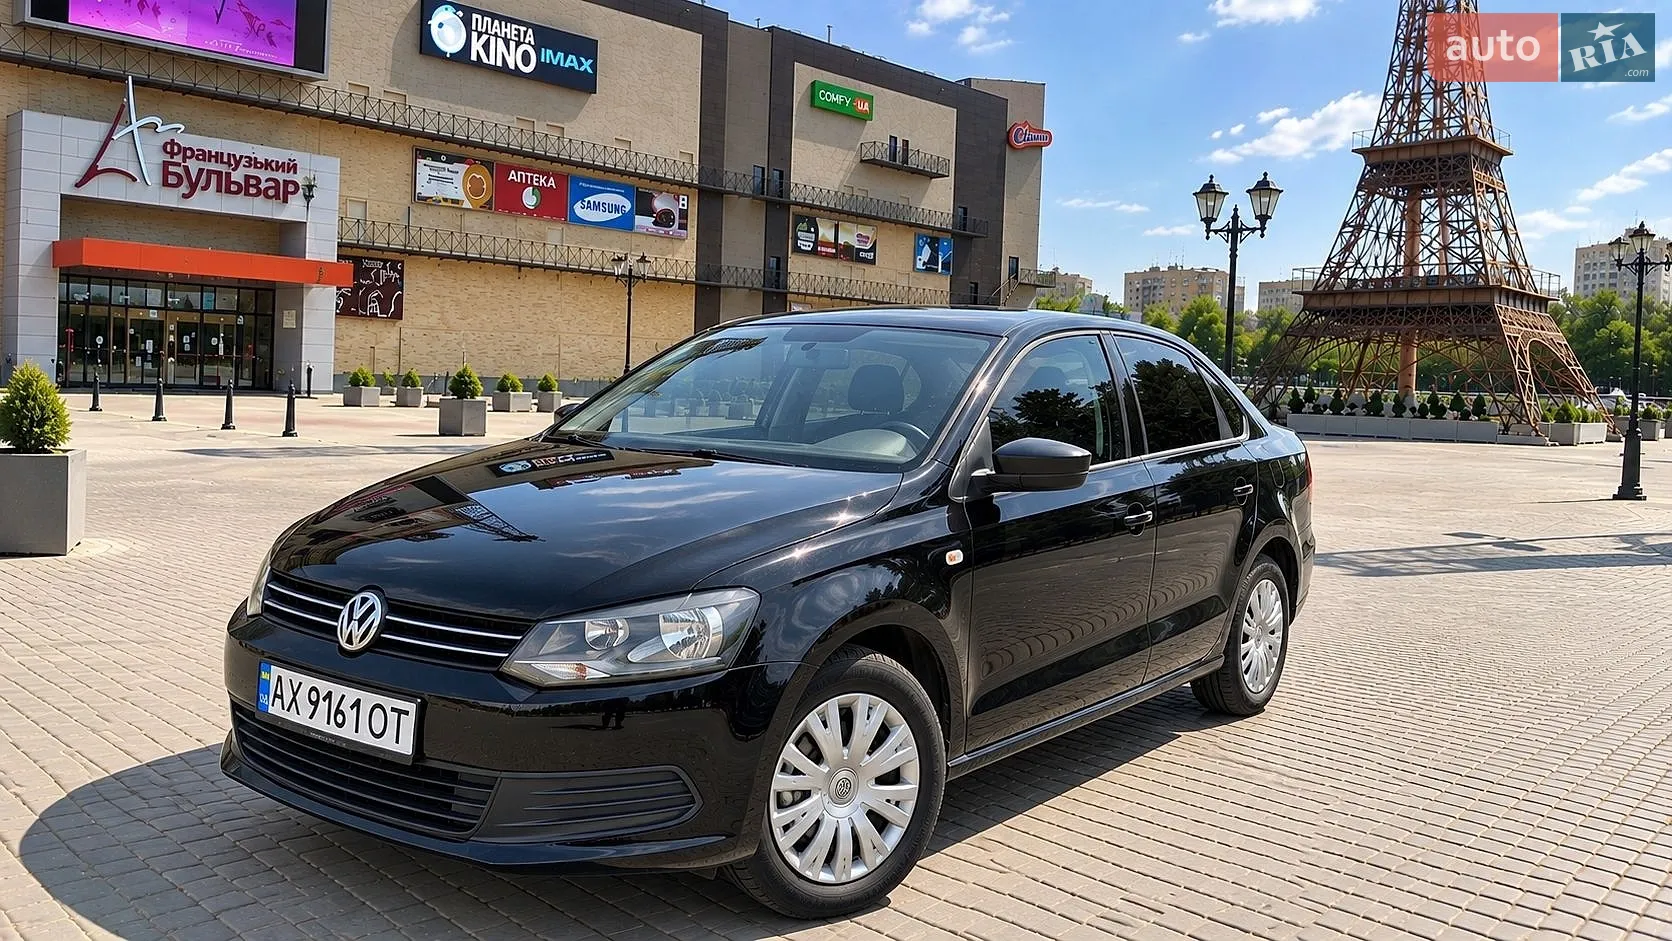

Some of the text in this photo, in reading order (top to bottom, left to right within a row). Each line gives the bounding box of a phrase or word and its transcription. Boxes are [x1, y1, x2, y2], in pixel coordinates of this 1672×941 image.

[471, 13, 535, 45] ПЛАНЕТА
[470, 31, 595, 74] KINO IMAX
[819, 89, 852, 107] COMFY
[162, 138, 298, 175] Французький
[161, 160, 301, 204] Бульвар
[507, 169, 557, 189] АПТЕКА
[580, 199, 627, 215] SAMSUNG
[307, 685, 362, 734] 9161
